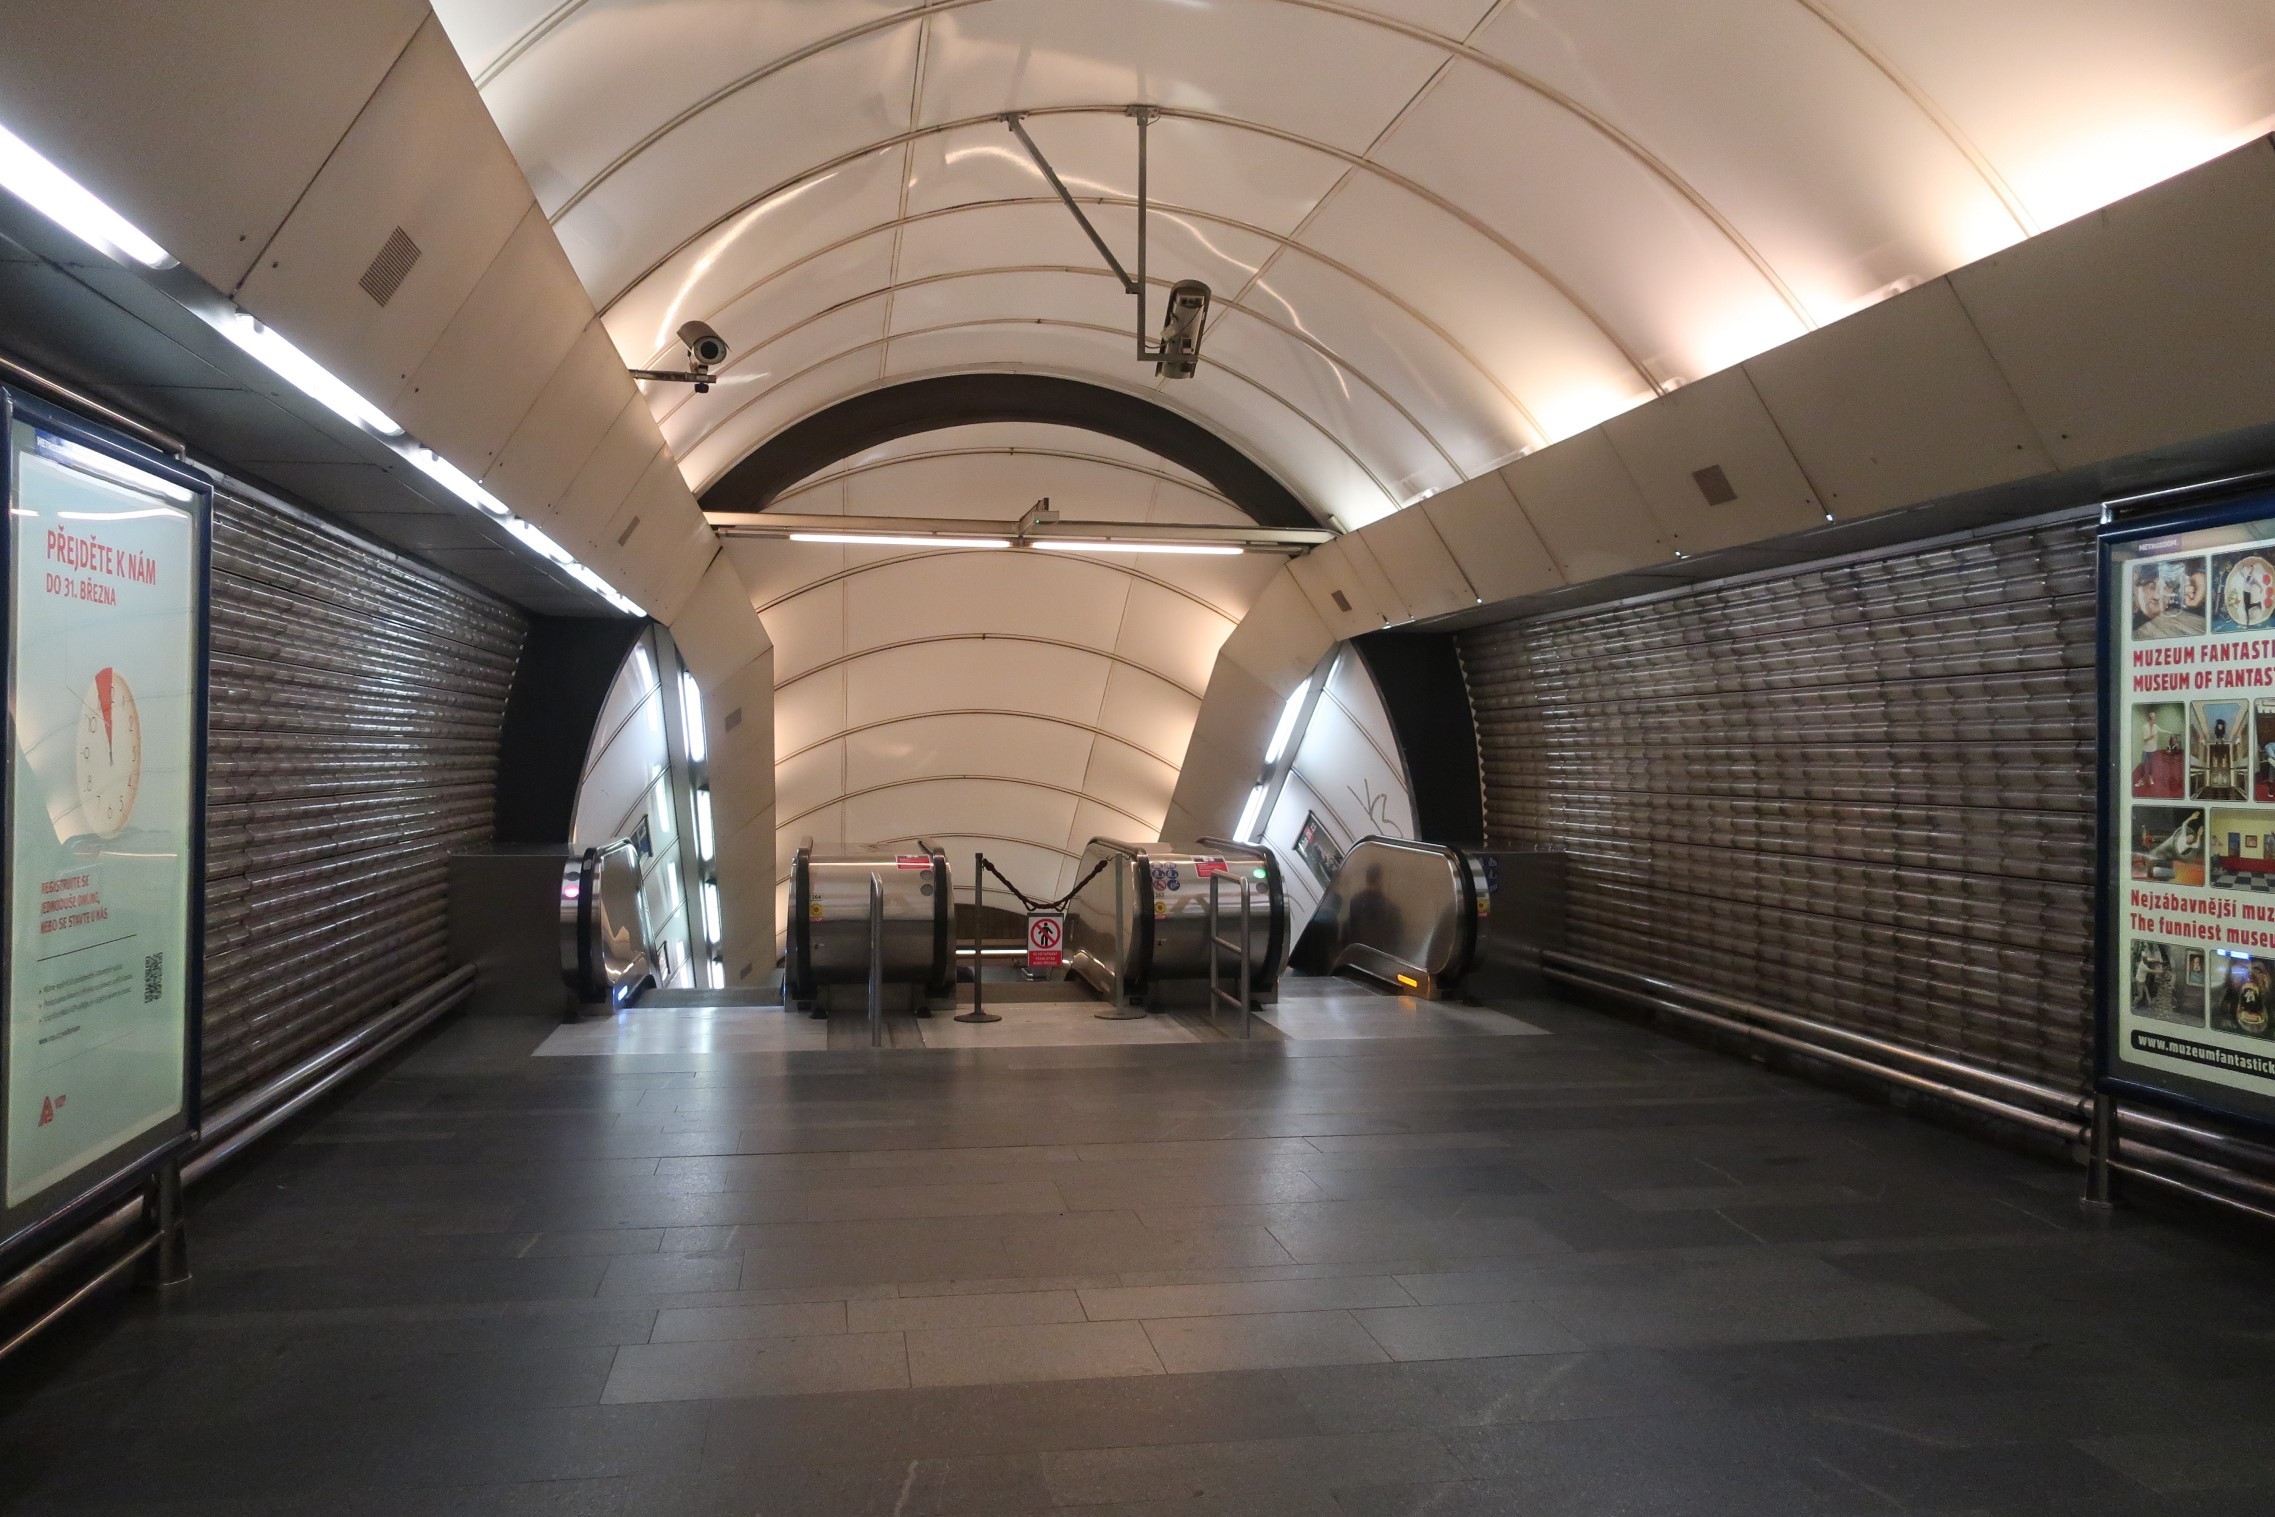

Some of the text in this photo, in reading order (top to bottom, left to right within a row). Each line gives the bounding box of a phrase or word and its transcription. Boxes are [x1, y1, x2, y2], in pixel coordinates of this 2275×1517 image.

[47, 524, 156, 586] PŘEJDĚTE K NÁM
[46, 572, 117, 606] DO 31. BŘEZNA
[2133, 645, 2195, 668] MUZEUM
[2133, 666, 2275, 692] MUSEUM OF FANTAS
[2131, 889, 2237, 919] Nejzábavnější
[2130, 912, 2155, 932] The
[2159, 916, 2222, 941] funniest
